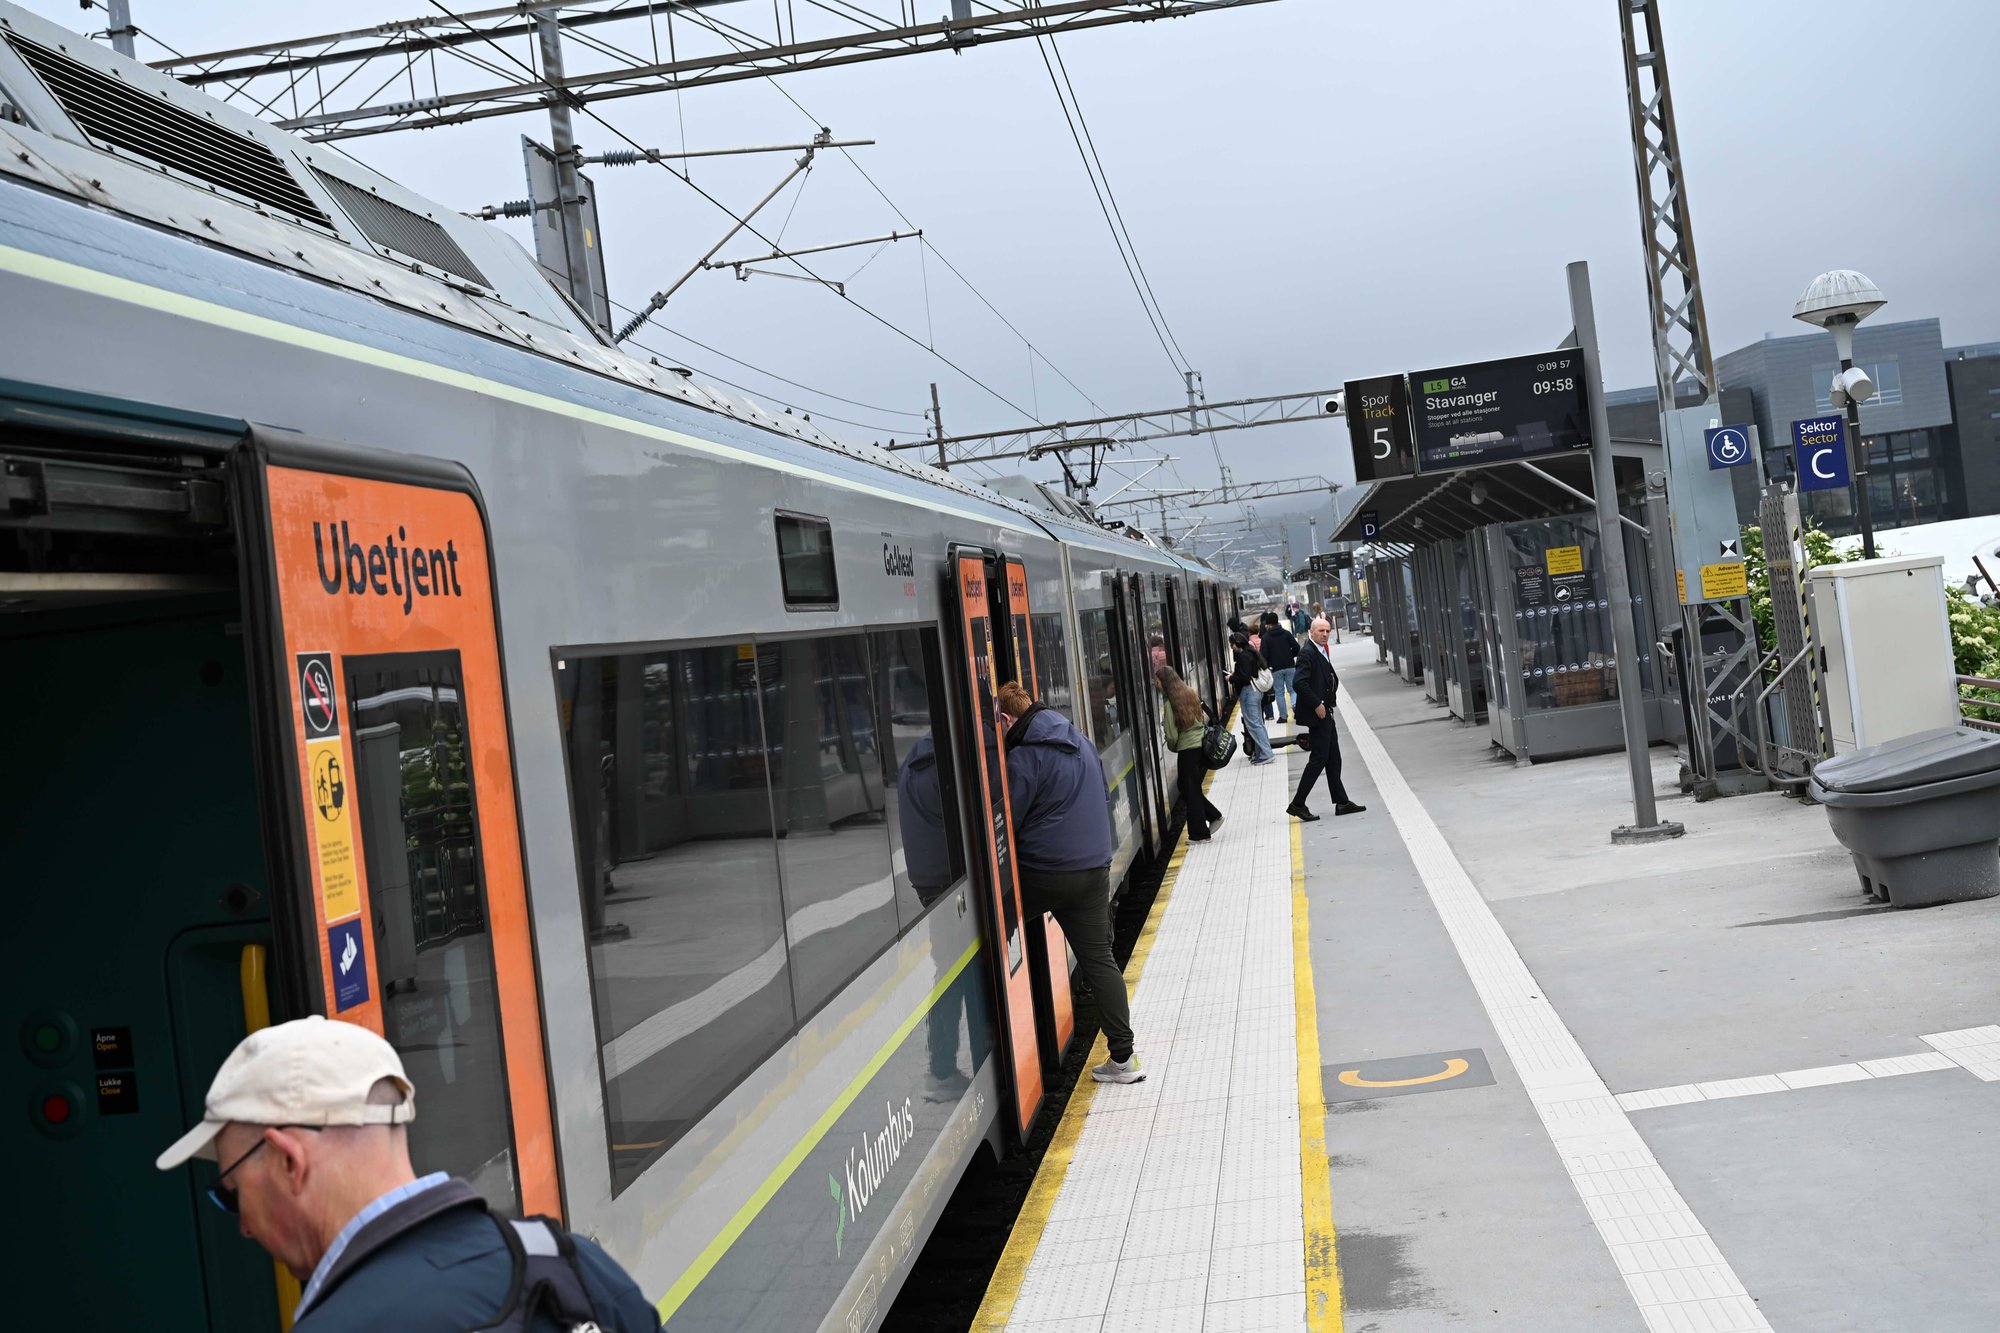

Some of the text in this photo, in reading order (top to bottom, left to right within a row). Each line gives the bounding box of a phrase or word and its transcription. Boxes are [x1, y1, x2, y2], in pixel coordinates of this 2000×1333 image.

[1546, 360, 1570, 371] 09 57
[1451, 377, 1467, 386] GA
[1533, 378, 1573, 395] 09:58
[1361, 394, 1389, 408] Spor
[1426, 391, 1498, 410] Stavanger
[1362, 407, 1395, 420] Track
[1427, 413, 1450, 422] Stopper
[1474, 406, 1500, 416] stasjoner
[1800, 421, 1837, 434] Sektor
[1373, 427, 1392, 459] 5
[1801, 433, 1838, 446] Sector
[1811, 448, 1836, 479] C
[1365, 523, 1376, 536] D
[883, 543, 915, 577] GoAhead
[313, 520, 462, 615] Ubetjent
[96, 1033, 116, 1043] Åpne
[97, 1042, 117, 1051] Open
[99, 1079, 122, 1087] Lukke
[101, 1087, 121, 1095] Close
[845, 1096, 914, 1223] Kolumbus
